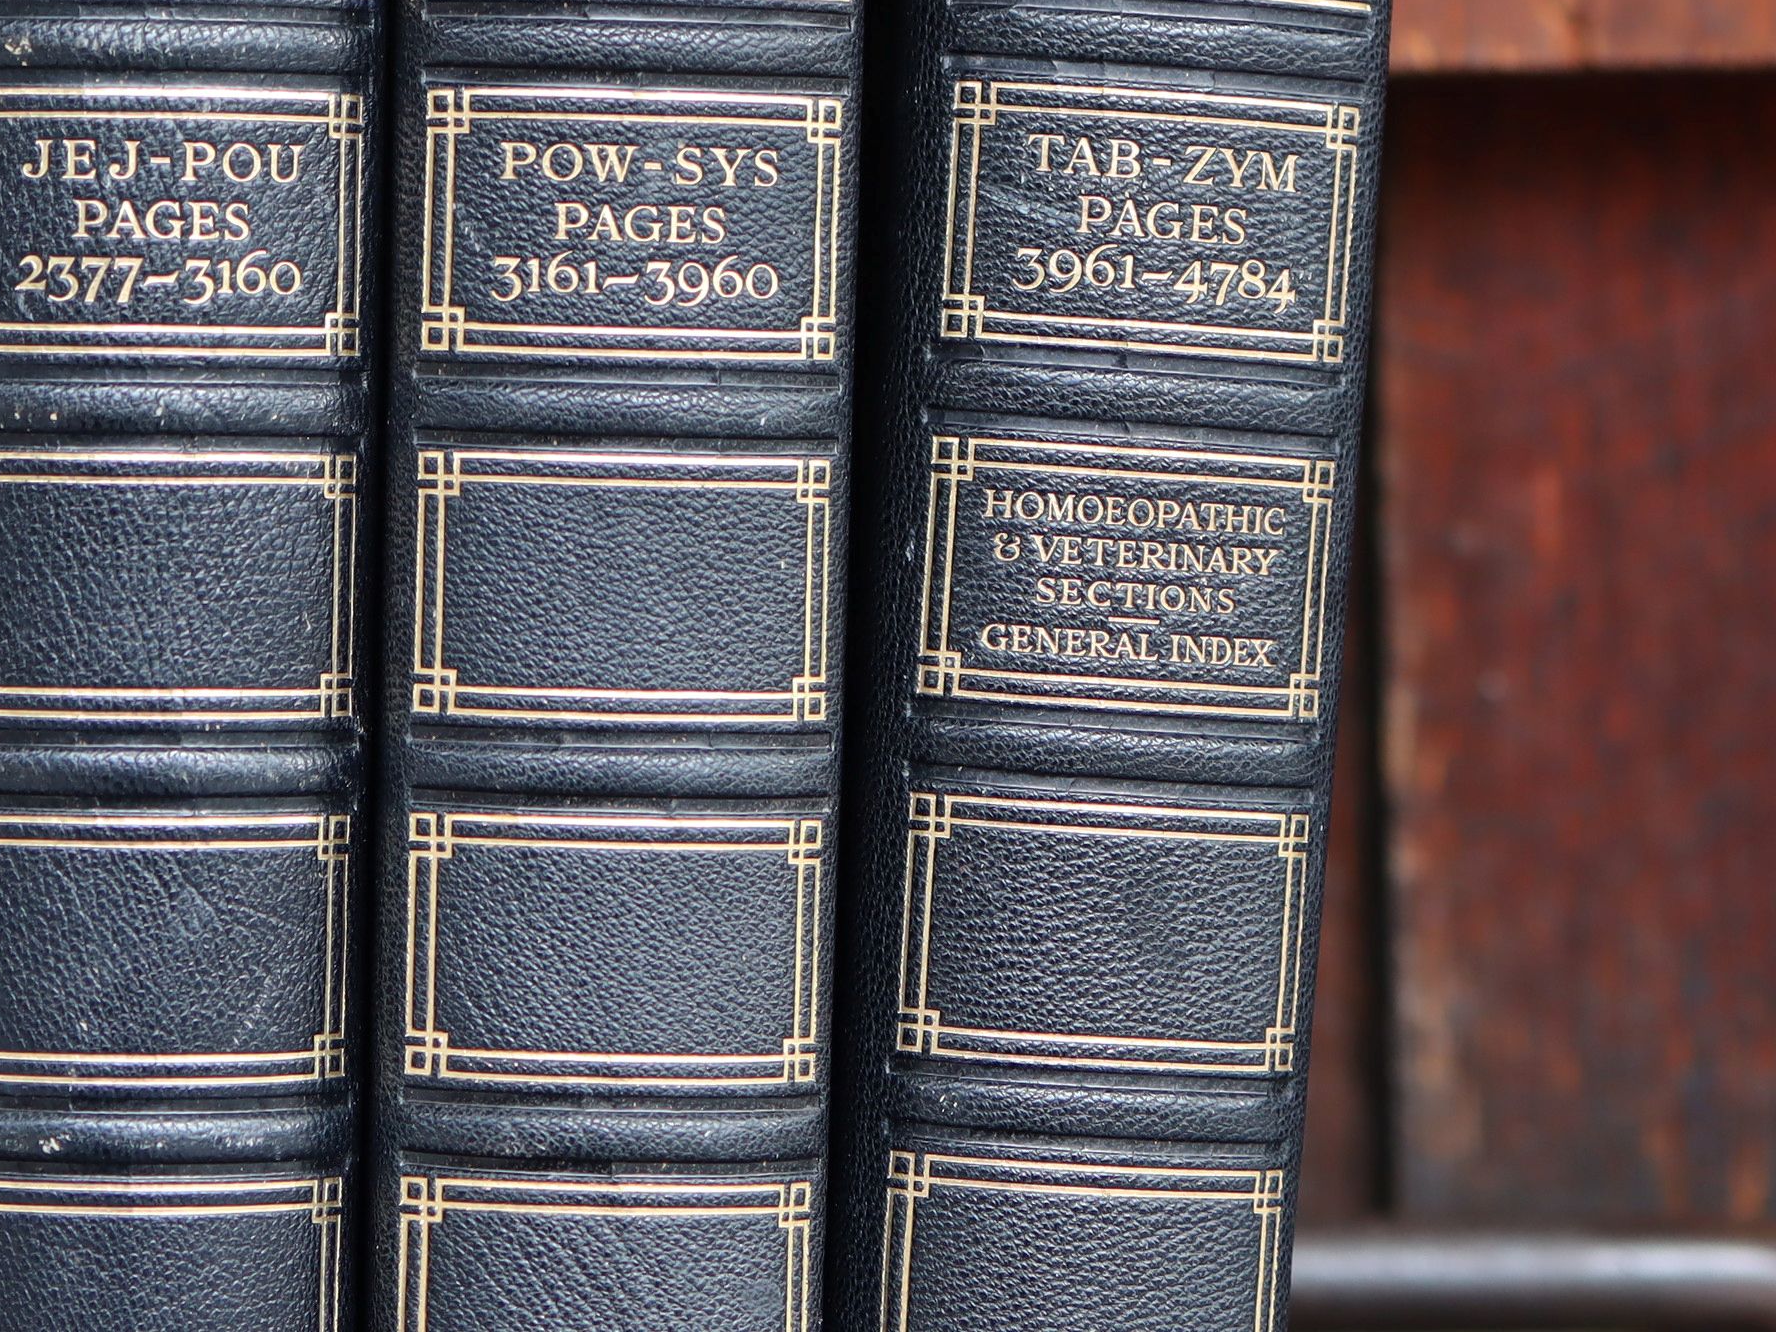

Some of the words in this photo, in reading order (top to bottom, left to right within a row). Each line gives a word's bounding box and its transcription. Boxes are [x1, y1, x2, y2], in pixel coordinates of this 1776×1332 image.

[22, 138, 306, 183] JEJ-POU
[499, 140, 780, 189] POW-SYS
[1025, 132, 1302, 195] TAB-ZYM
[72, 199, 252, 242] PAGES
[554, 202, 727, 246] PAGES
[1077, 194, 1249, 246] PAGES
[981, 488, 1286, 536] HOMOEOPATHIC
[993, 531, 1020, 562] &
[1029, 534, 1280, 576] VETERINARY
[1034, 576, 1237, 614] SECTIONS
[979, 623, 1160, 662] GENERAL
[1167, 633, 1278, 668] INDEX
